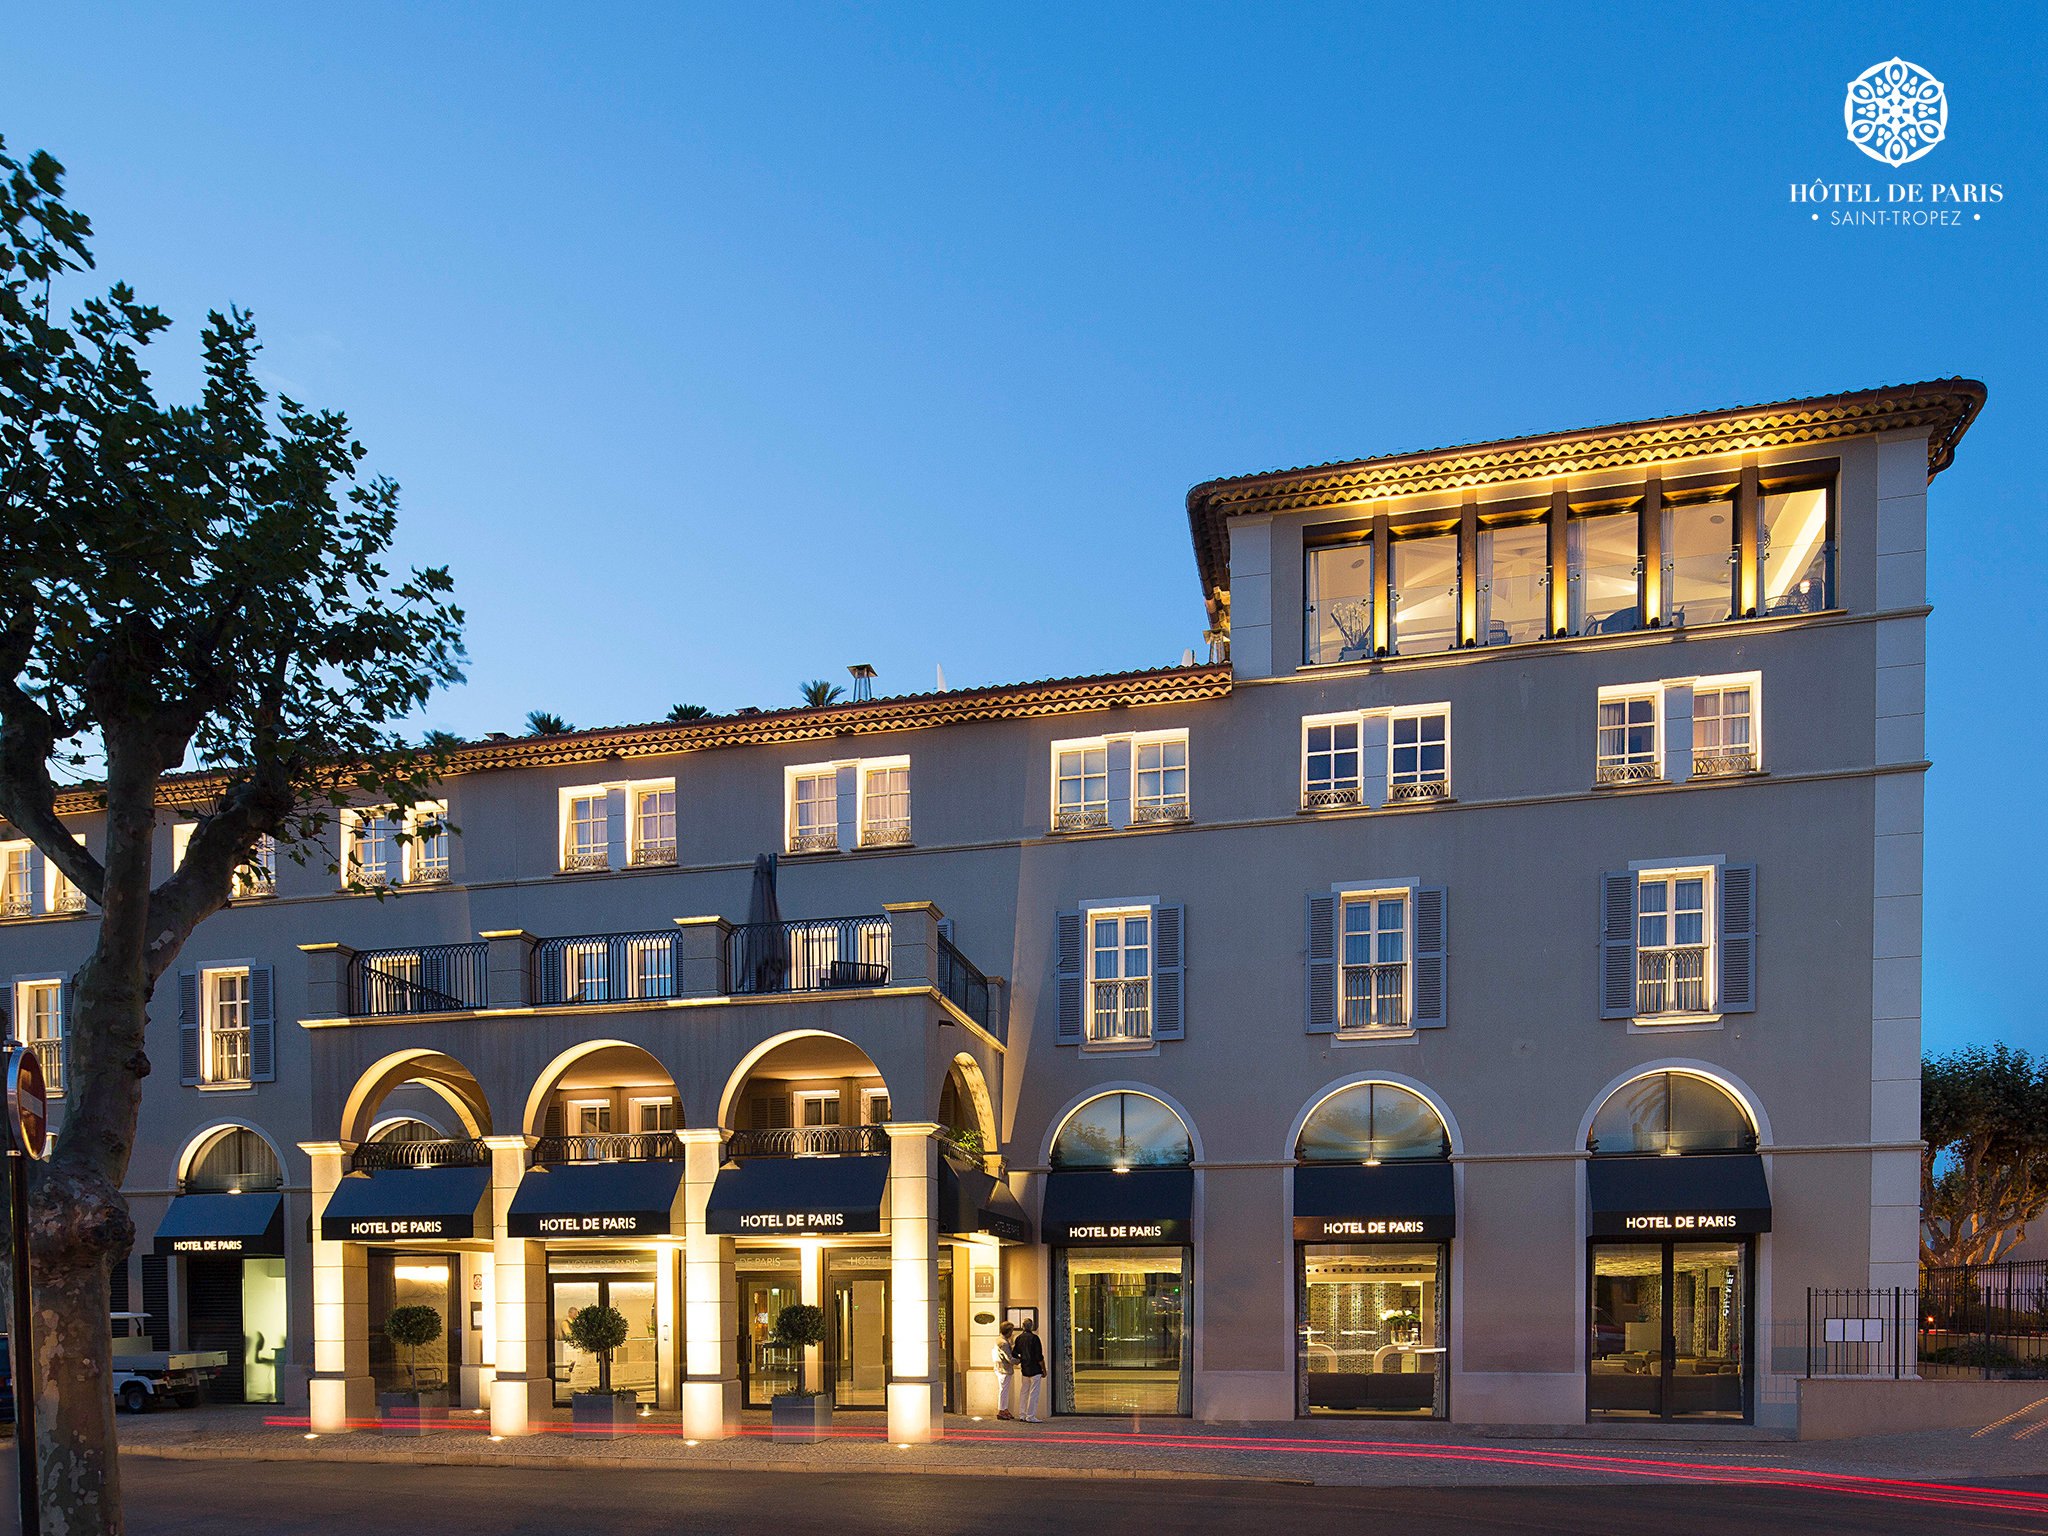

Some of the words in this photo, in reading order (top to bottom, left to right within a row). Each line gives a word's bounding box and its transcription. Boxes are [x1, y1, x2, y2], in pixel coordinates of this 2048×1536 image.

[540, 1218, 578, 1230] HOTEL
[582, 1218, 599, 1230] DE
[603, 1216, 637, 1229] PARIS
[741, 1215, 783, 1227] HOTEL
[787, 1215, 805, 1226] DE
[808, 1213, 844, 1226] PARIS
[1627, 1217, 1672, 1229] HOTEL
[1674, 1216, 1695, 1228] DE
[1698, 1215, 1737, 1227] PARIS
[351, 1222, 389, 1235] HOTEL
[391, 1222, 408, 1234] DE
[410, 1221, 442, 1233] PARIS
[1069, 1227, 1109, 1238] HOTEL
[1110, 1226, 1127, 1238] DE
[1129, 1225, 1161, 1237] PARIS
[1323, 1222, 1366, 1234] HOTEL
[1368, 1222, 1386, 1233] DE
[1389, 1221, 1424, 1233] PARIS
[173, 1241, 204, 1251] HOTEL
[204, 1241, 217, 1251] DE
[218, 1240, 242, 1250] PARIS
[755, 1257, 781, 1267] PARIS
[850, 1256, 881, 1266] HOTEL
[983, 1276, 991, 1284] H
